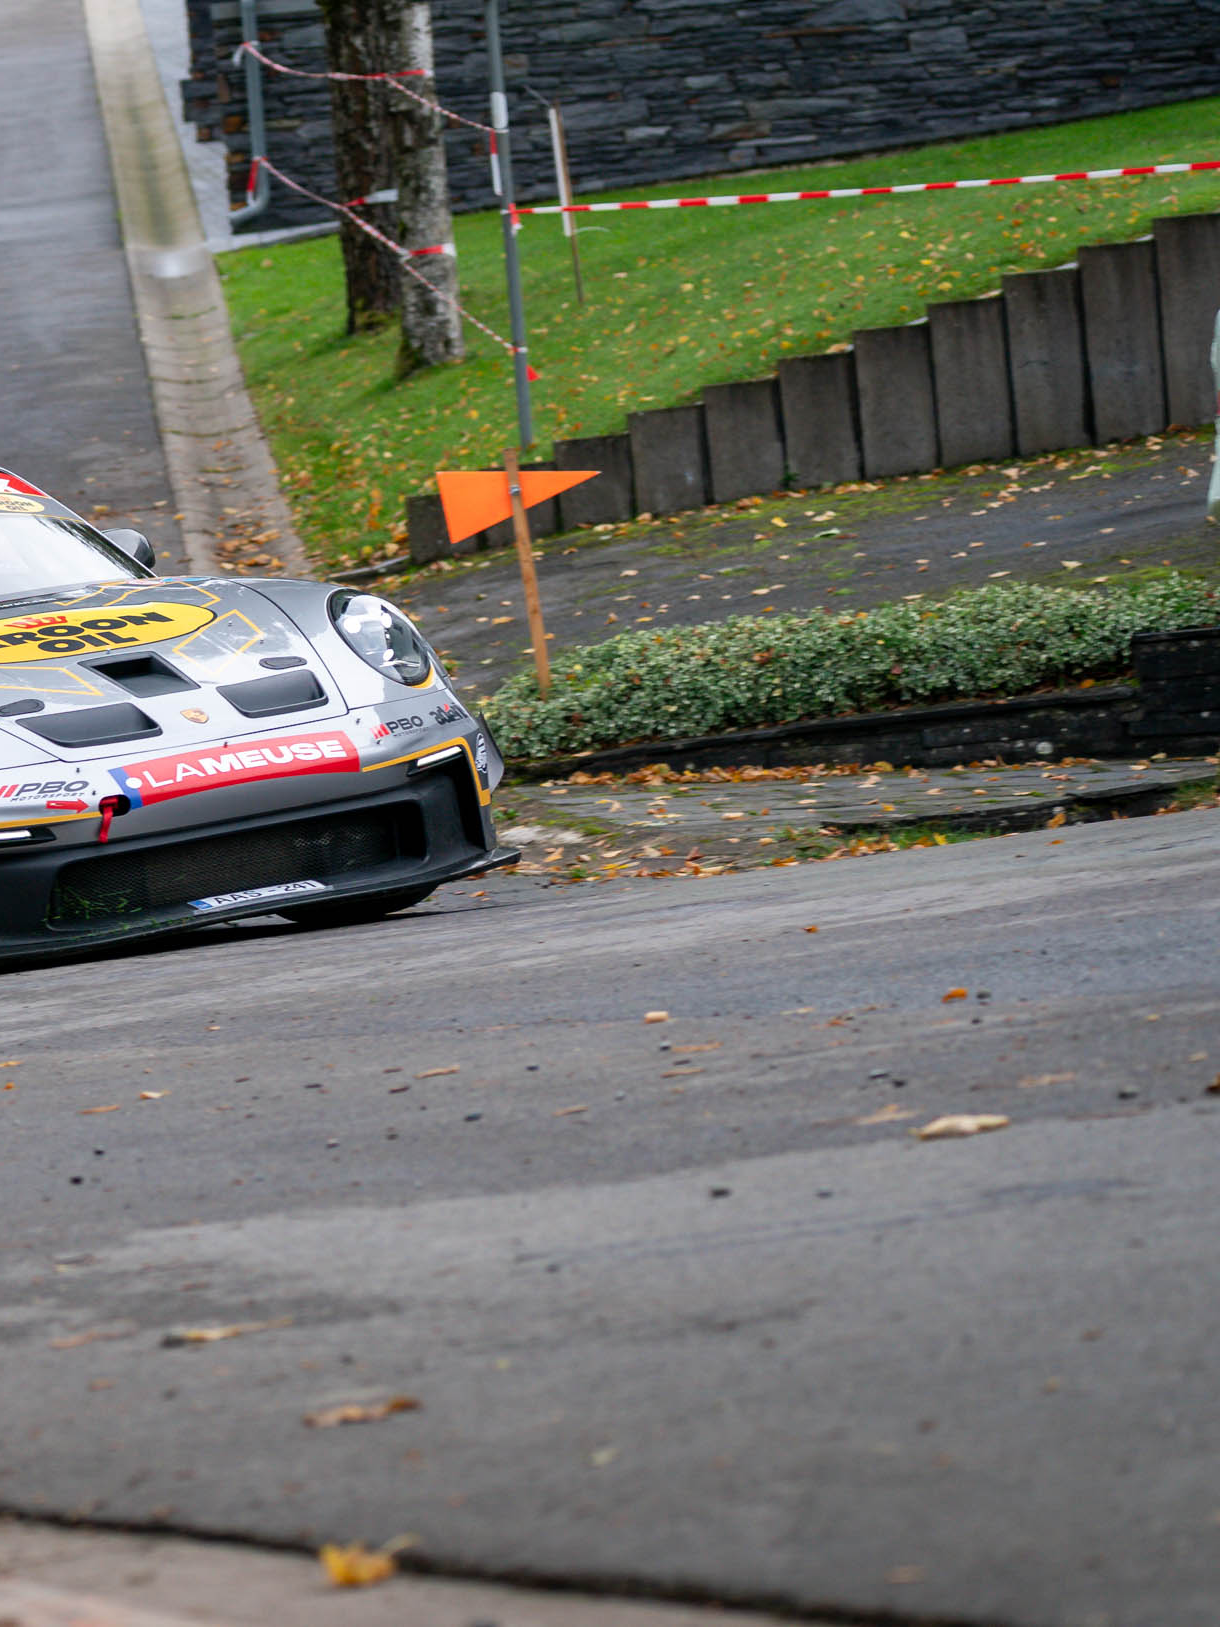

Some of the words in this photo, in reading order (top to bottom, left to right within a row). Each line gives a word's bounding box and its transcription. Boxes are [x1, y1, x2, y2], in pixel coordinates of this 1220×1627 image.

[36, 632, 140, 653] OIL
[385, 715, 424, 734] PBO
[10, 792, 85, 803] MOTORSPORT
[15, 780, 90, 797] PBO
